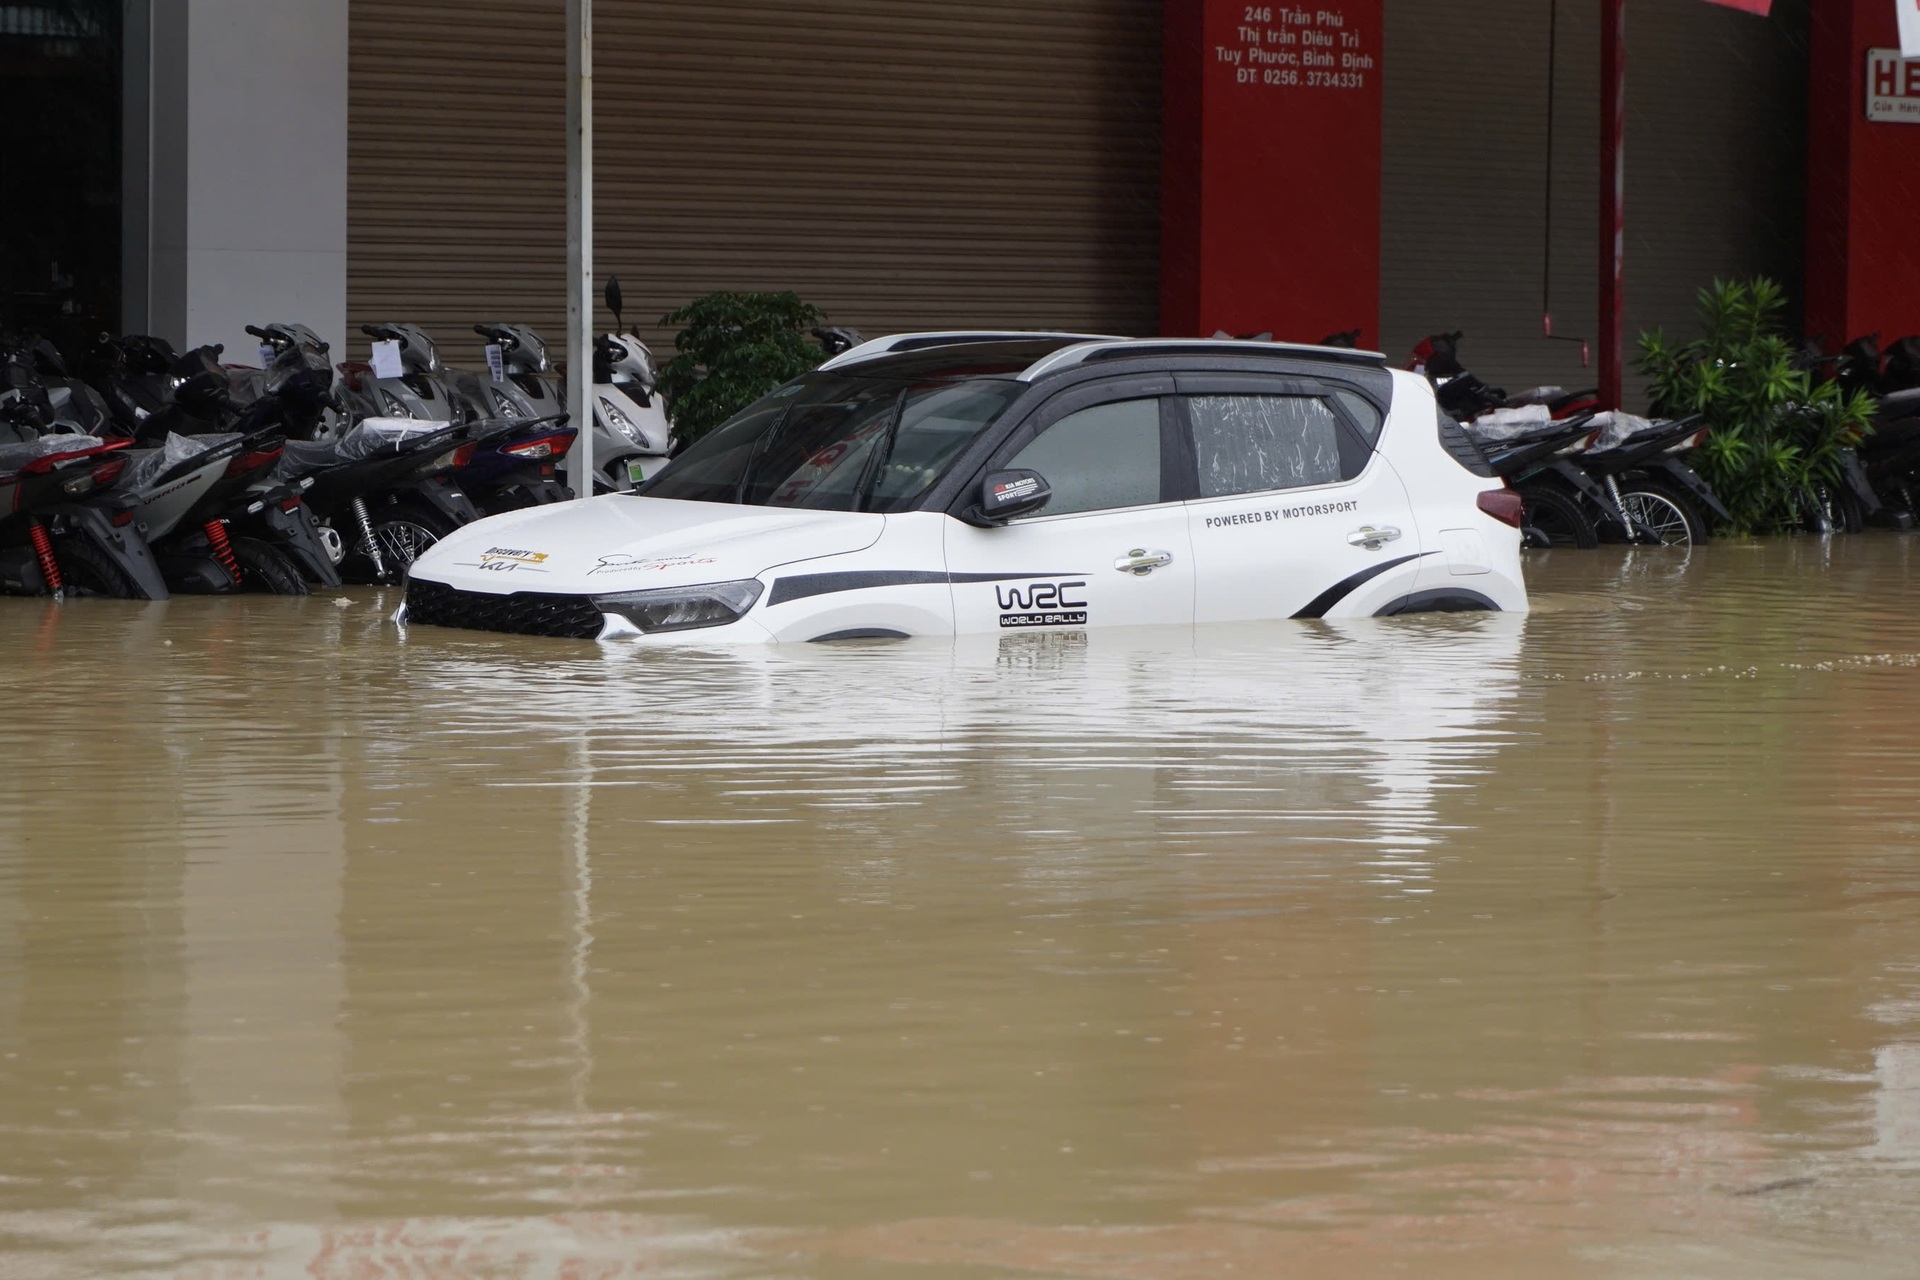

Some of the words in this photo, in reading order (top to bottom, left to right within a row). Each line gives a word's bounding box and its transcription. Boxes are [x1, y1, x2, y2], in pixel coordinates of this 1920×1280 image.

[1245, 6, 1271, 23] 246
[1316, 10, 1343, 27] Phú
[1238, 26, 1260, 46] Thị
[1216, 46, 1242, 66] Tuy
[1303, 47, 1334, 66] Bình
[1342, 53, 1373, 71] Định
[997, 491, 1018, 502] SPORT
[1206, 512, 1262, 528] POWERED
[1265, 510, 1279, 522] BY
[1283, 500, 1358, 520] MOTORSPORT
[995, 581, 1088, 610] WRC
[1001, 615, 1043, 625] WORLD
[1045, 613, 1086, 623] RALLY
